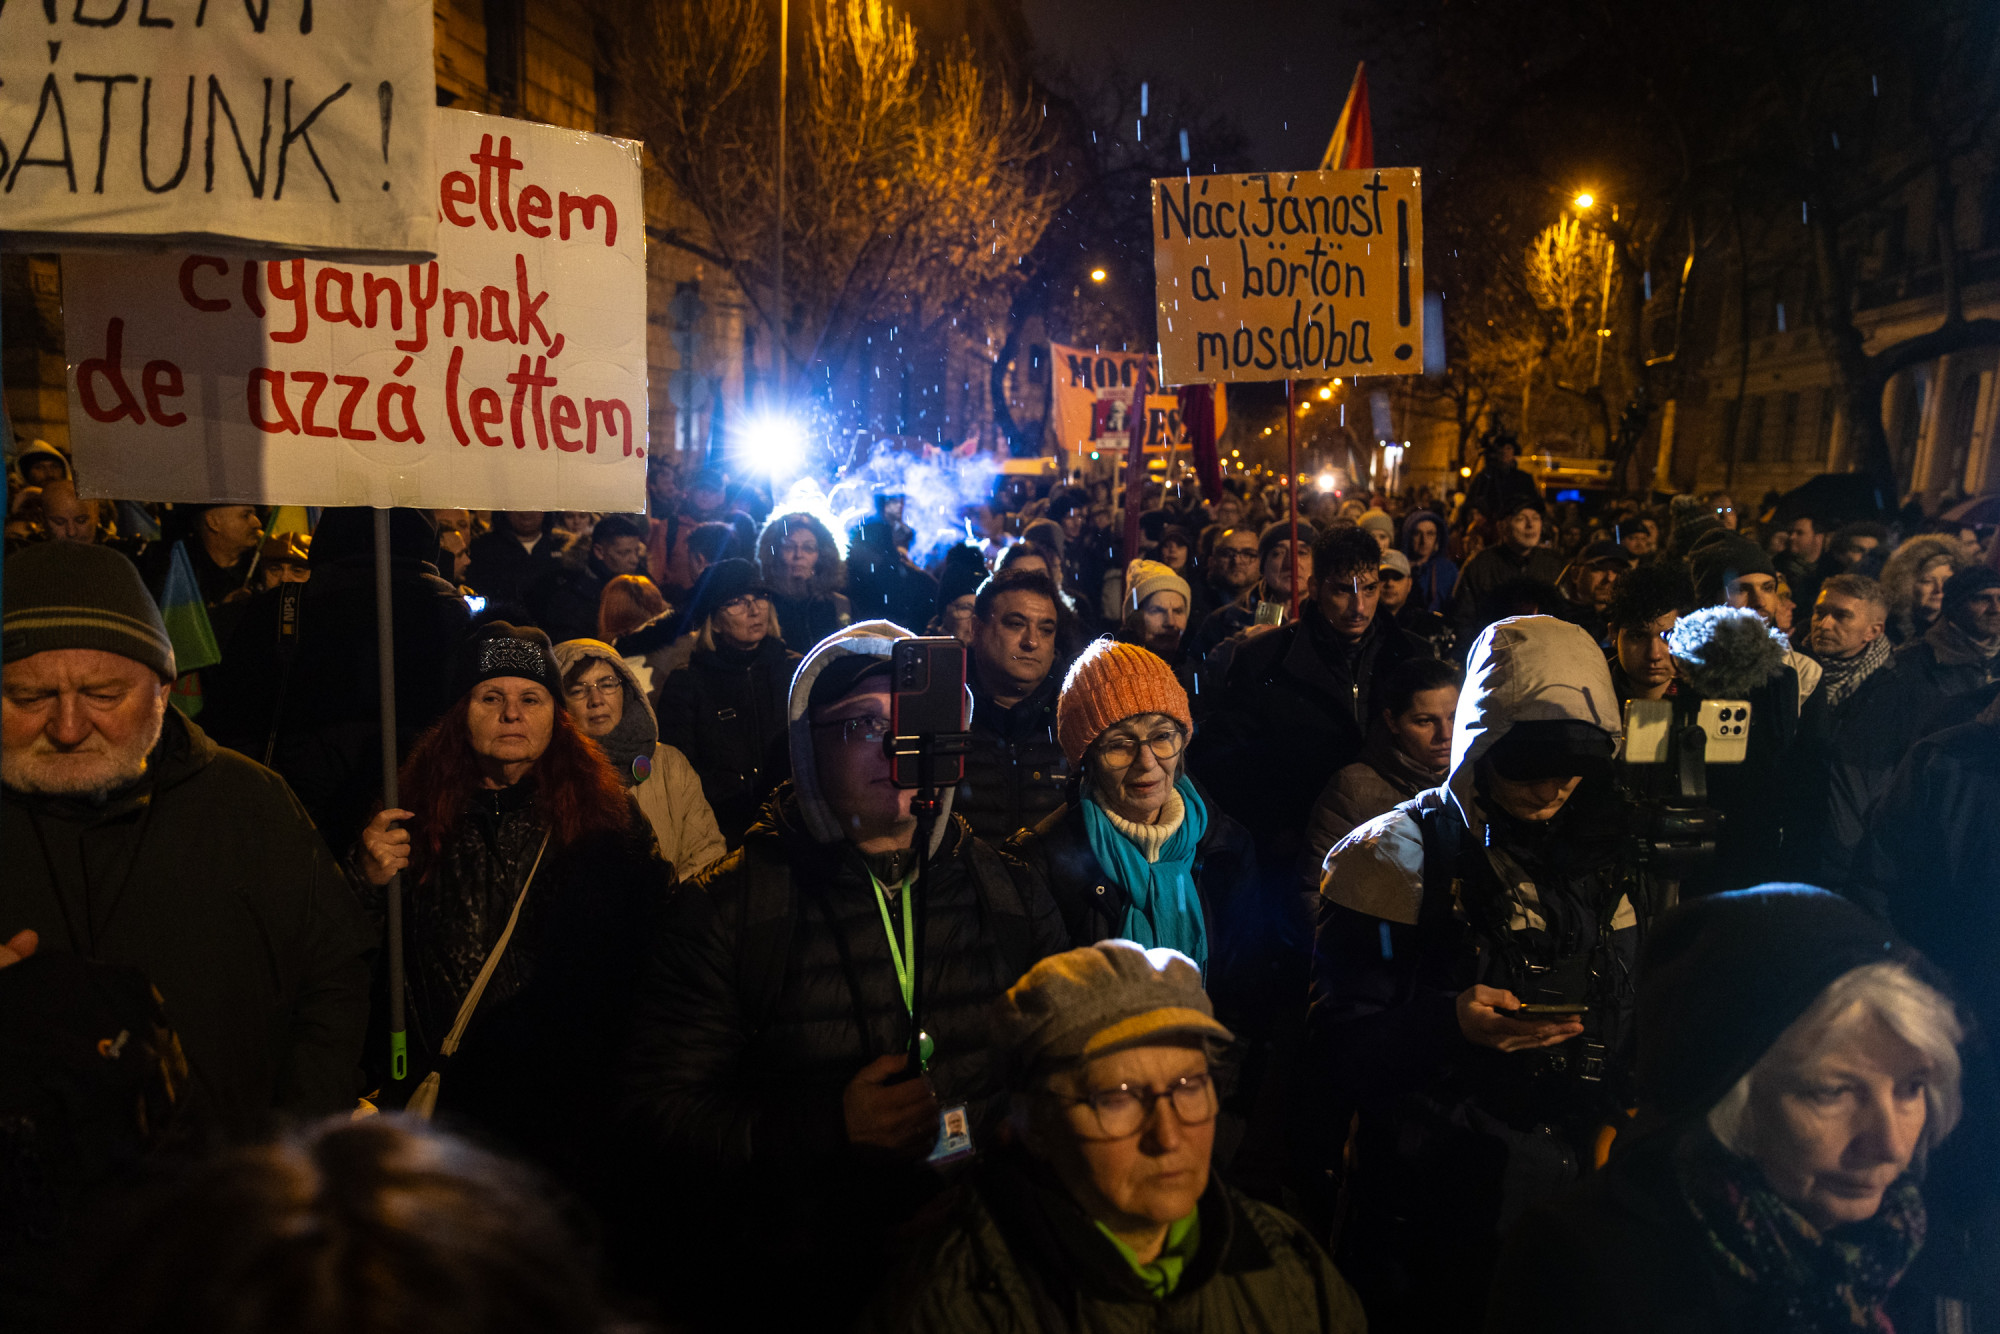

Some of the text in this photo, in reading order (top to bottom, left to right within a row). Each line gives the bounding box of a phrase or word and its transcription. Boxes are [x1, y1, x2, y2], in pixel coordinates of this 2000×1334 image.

[0, 41, 394, 203] ÁTUNK!
[439, 133, 618, 247] ettem
[1191, 237, 1366, 301] a börtön
[76, 317, 646, 458] de azzá lettem.
[1197, 300, 1374, 372] mosdóba
